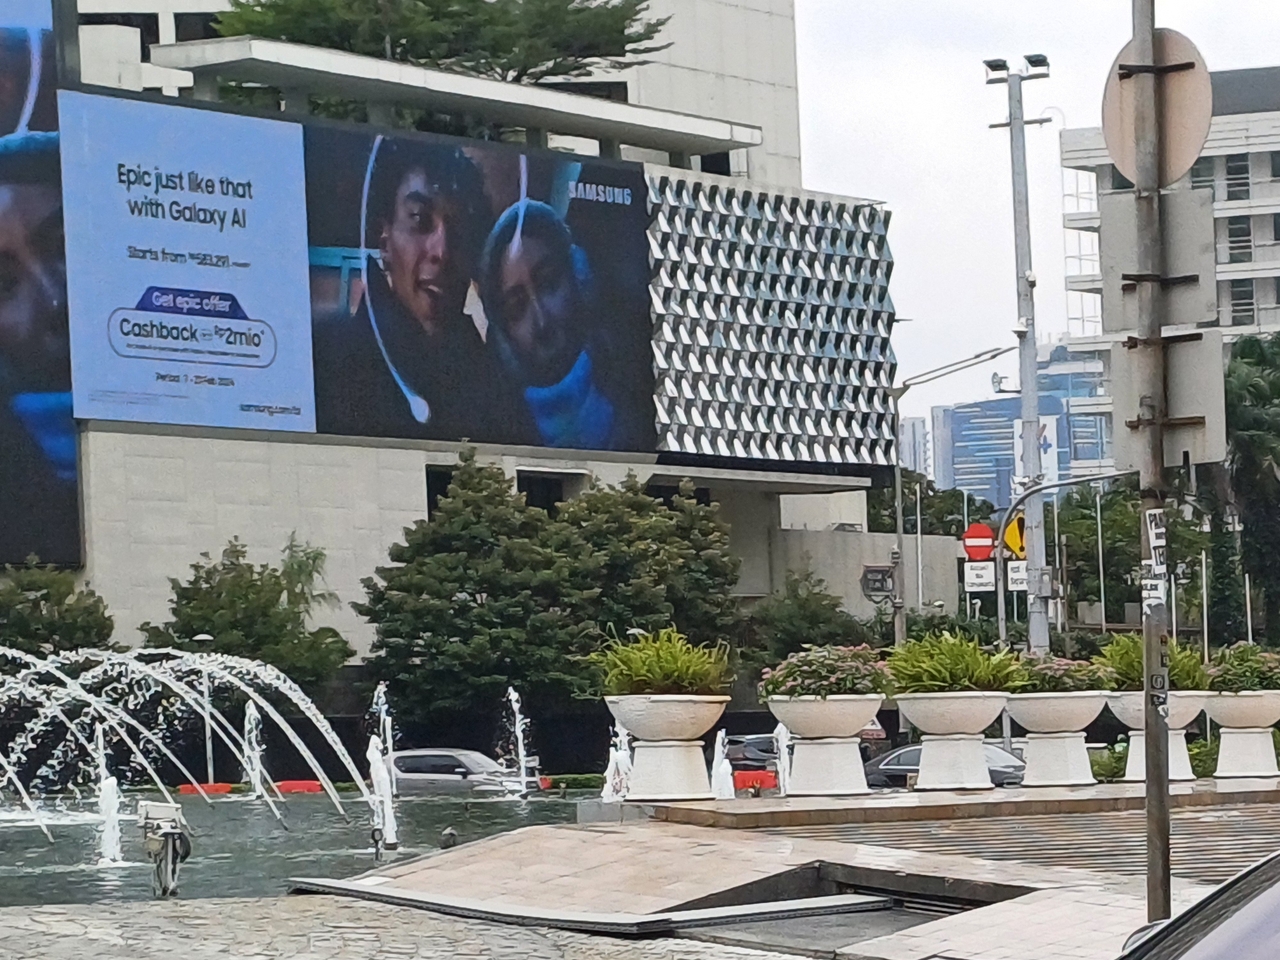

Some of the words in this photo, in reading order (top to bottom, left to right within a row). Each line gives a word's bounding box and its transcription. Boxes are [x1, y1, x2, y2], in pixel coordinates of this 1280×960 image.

[117, 163, 152, 193] Epic
[154, 166, 184, 195] just
[187, 170, 215, 194] like
[219, 177, 253, 199] that
[568, 181, 632, 206] SAMSUNG
[127, 195, 166, 219] with
[169, 200, 227, 233] Galaxy
[231, 207, 247, 228] AI
[152, 291, 174, 306] Get
[176, 293, 201, 313] epic
[202, 295, 233, 312] offer
[119, 318, 199, 342] Cashback
